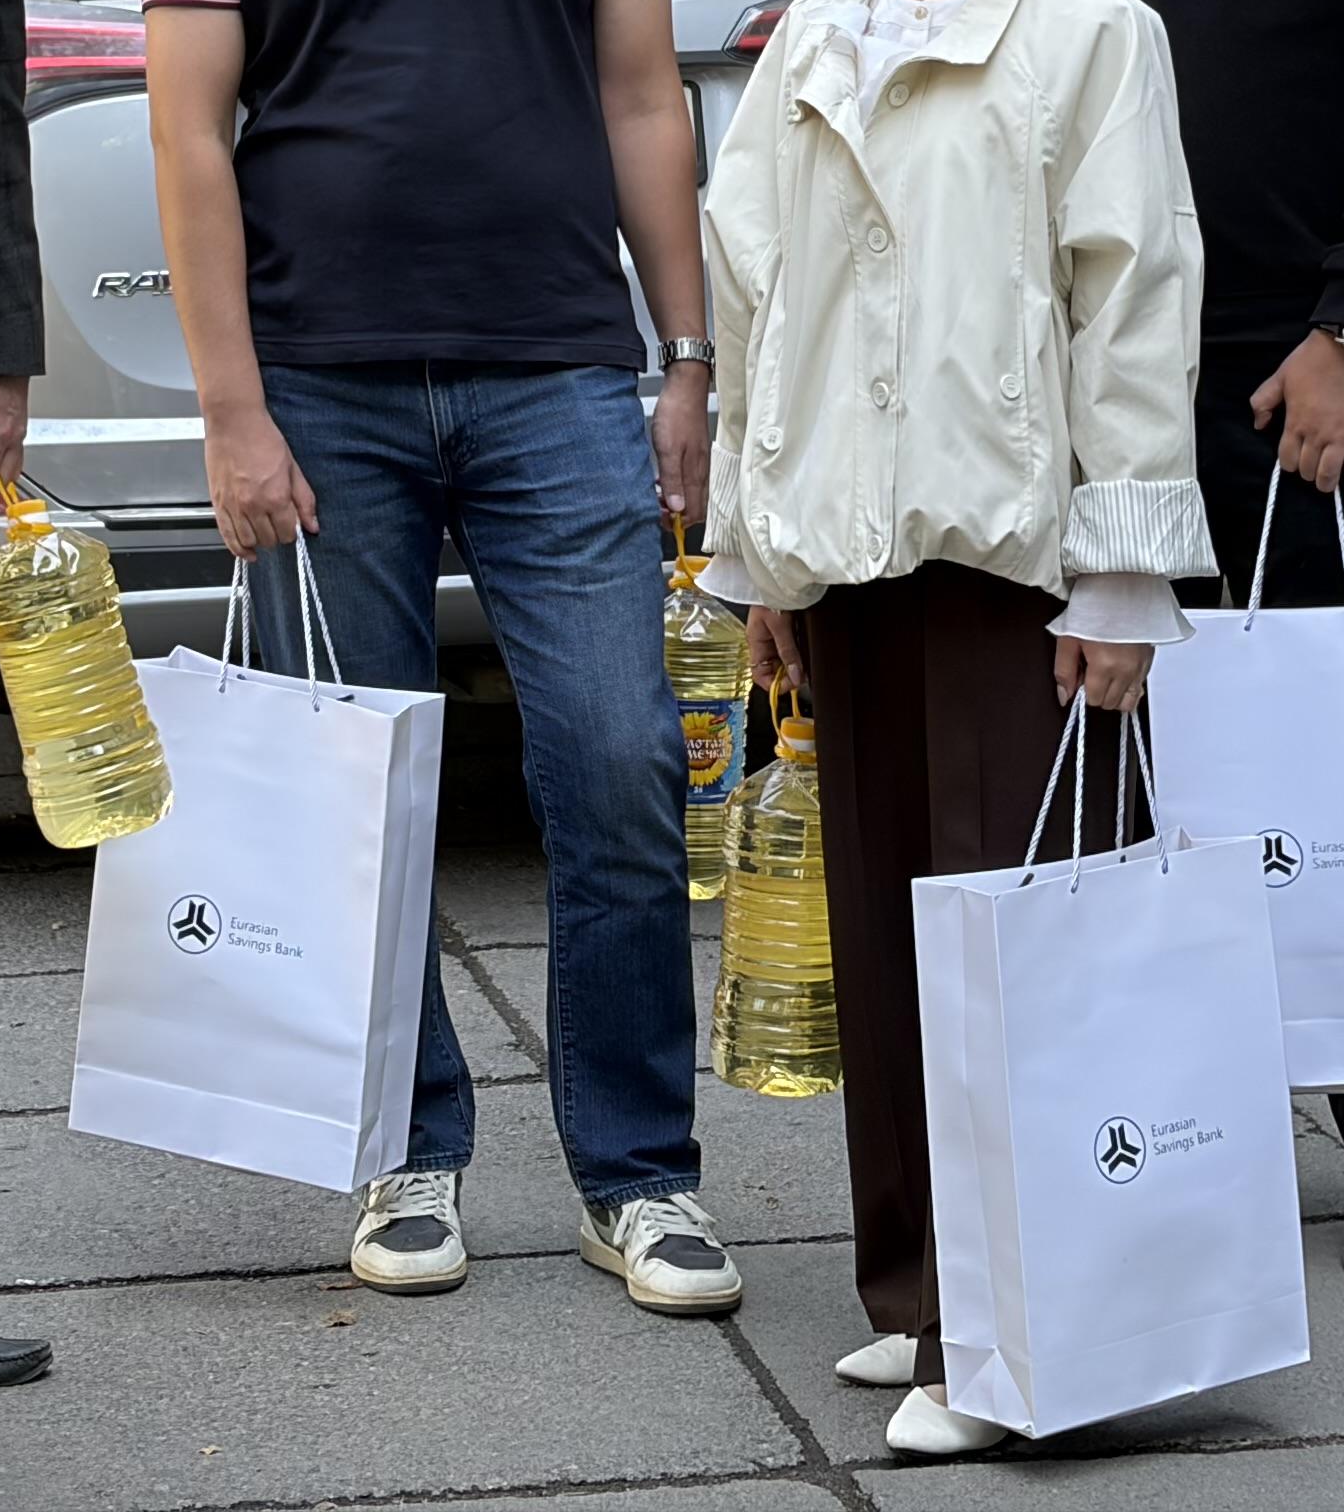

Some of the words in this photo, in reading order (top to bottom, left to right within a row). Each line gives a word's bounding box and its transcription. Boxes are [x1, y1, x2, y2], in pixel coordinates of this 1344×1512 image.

[230, 916, 279, 937] Eurasian
[227, 932, 272, 954] Savings
[275, 942, 303, 959] Bank
[1151, 1118, 1197, 1138] Eurasian
[1153, 1136, 1195, 1156] Savings
[1197, 1127, 1224, 1145] Bank
